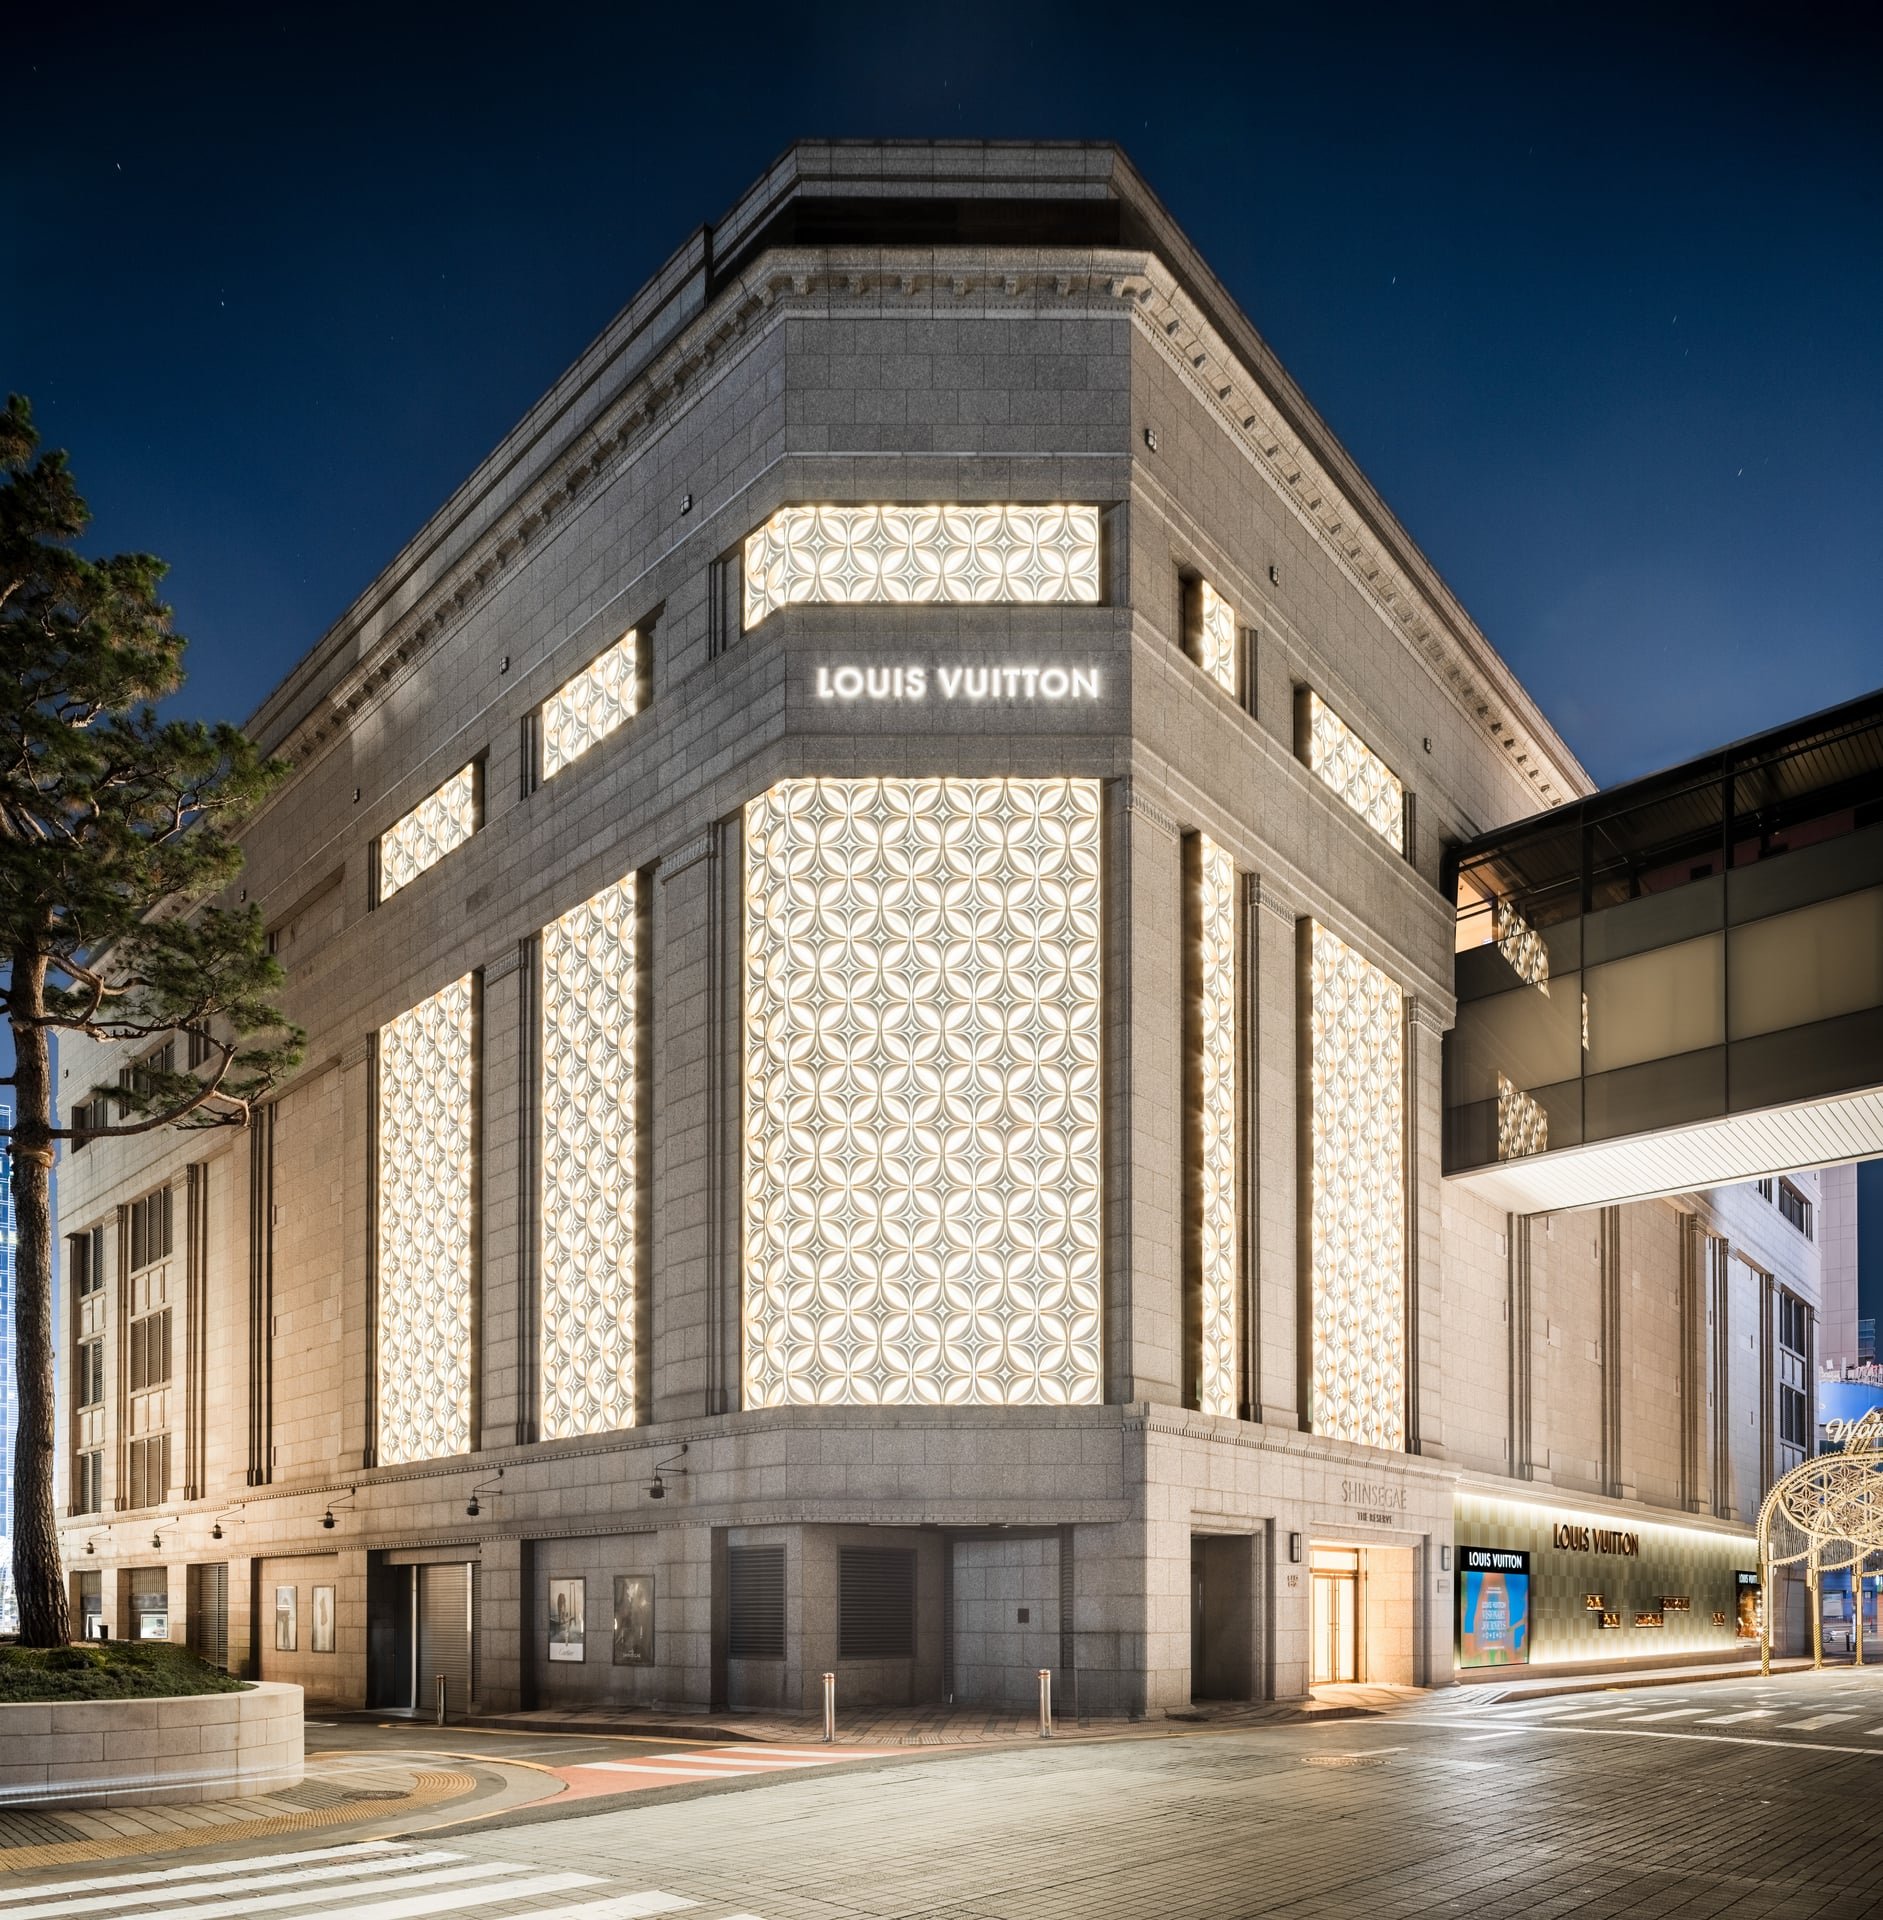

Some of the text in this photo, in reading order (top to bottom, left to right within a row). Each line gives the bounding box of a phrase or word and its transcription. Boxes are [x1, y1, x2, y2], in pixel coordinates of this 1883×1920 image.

[816, 667, 1098, 698] LOUIS VUITTON
[1341, 1480, 1407, 1509] SHINSEGAE
[1357, 1511, 1392, 1524] THE RESERVE
[1553, 1523, 1639, 1558] LOUIS VUITTON
[1469, 1552, 1522, 1568] LOUIS VUITTON
